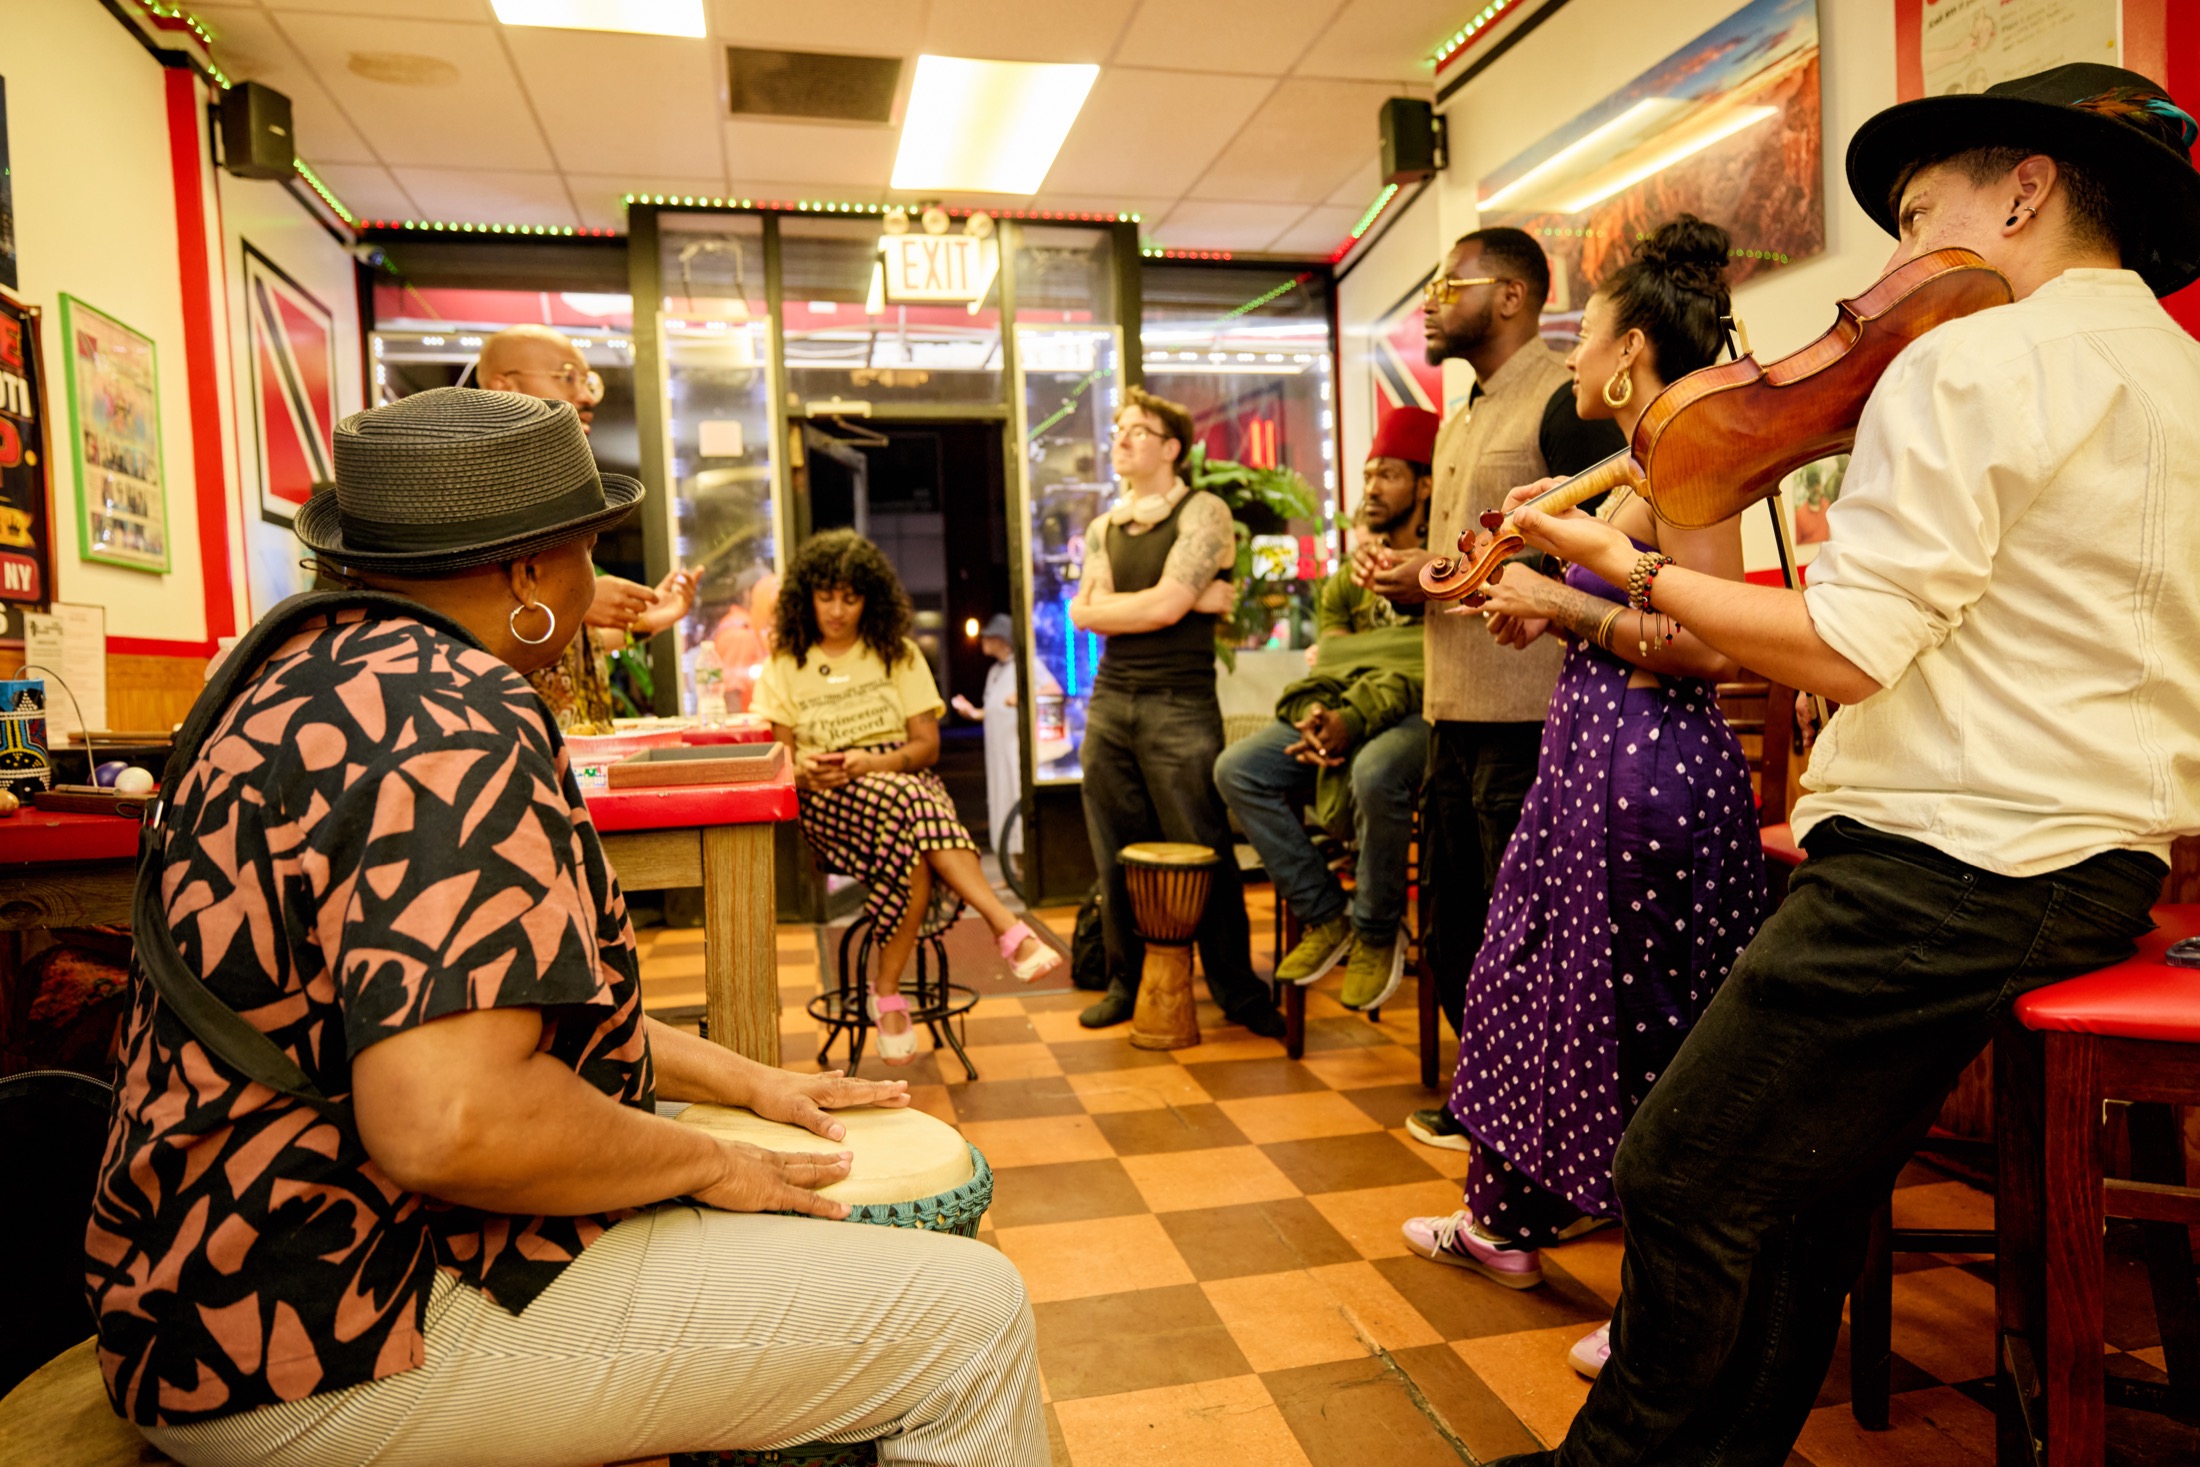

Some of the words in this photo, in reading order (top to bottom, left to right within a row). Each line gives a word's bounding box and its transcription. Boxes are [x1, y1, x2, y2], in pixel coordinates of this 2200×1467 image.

[902, 241, 969, 290] EXIT
[4, 561, 33, 592] NY
[819, 704, 889, 731] Princeton
[827, 715, 884, 741] Record
